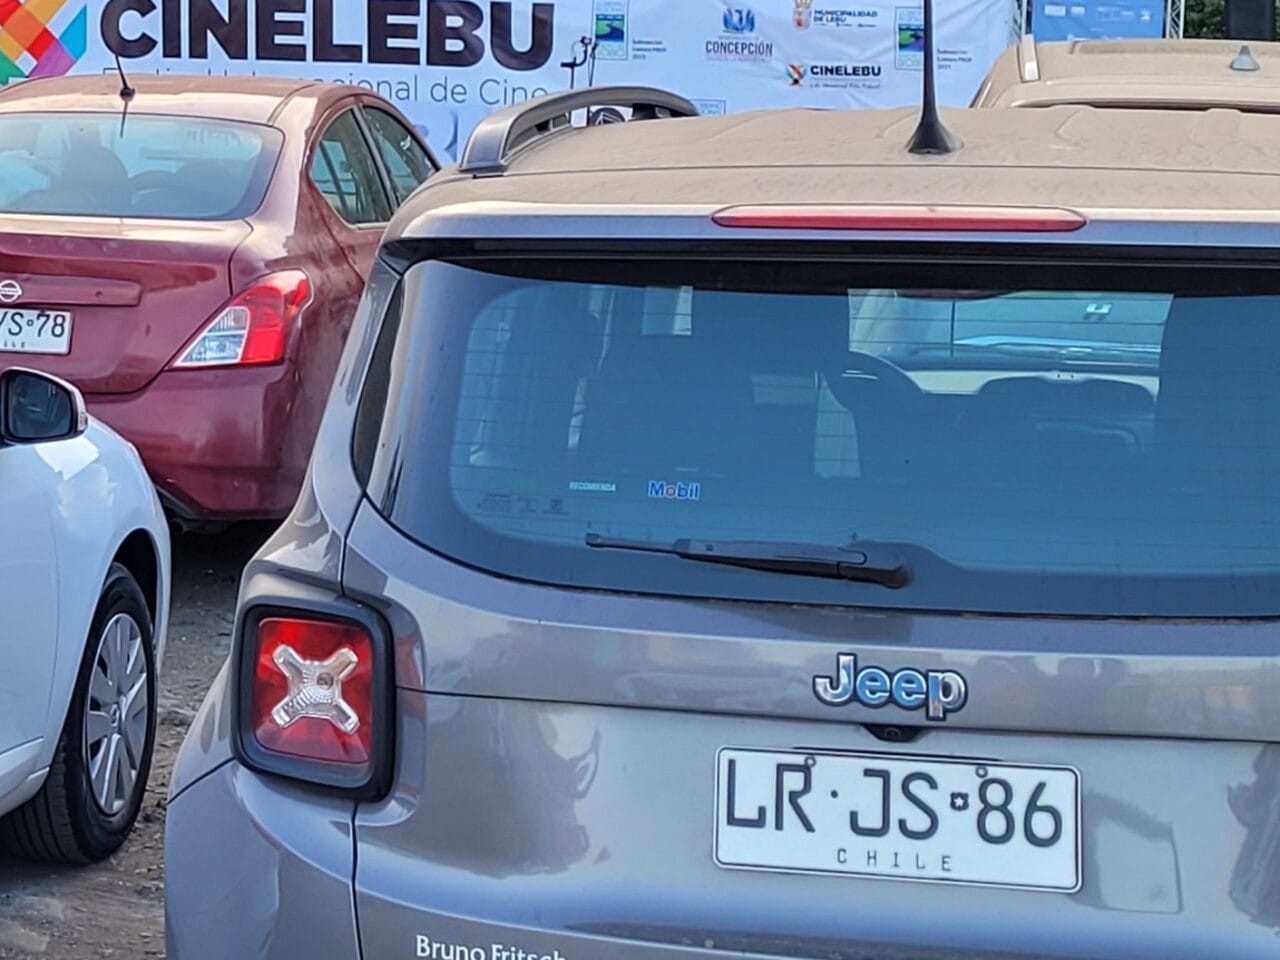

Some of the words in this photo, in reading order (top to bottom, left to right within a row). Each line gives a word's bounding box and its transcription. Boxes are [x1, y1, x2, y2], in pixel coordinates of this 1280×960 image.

[814, 9, 878, 18] MUNICIPALIDAD
[705, 40, 773, 57] CONCEPCIÓN
[810, 65, 881, 77] CINELEBU
[430, 77, 468, 104] de
[648, 480, 700, 500] Mobil
[812, 652, 968, 721] Jeep
[837, 848, 952, 872] CHILE
[416, 934, 486, 960] Bruno
[492, 943, 567, 960] Frit
